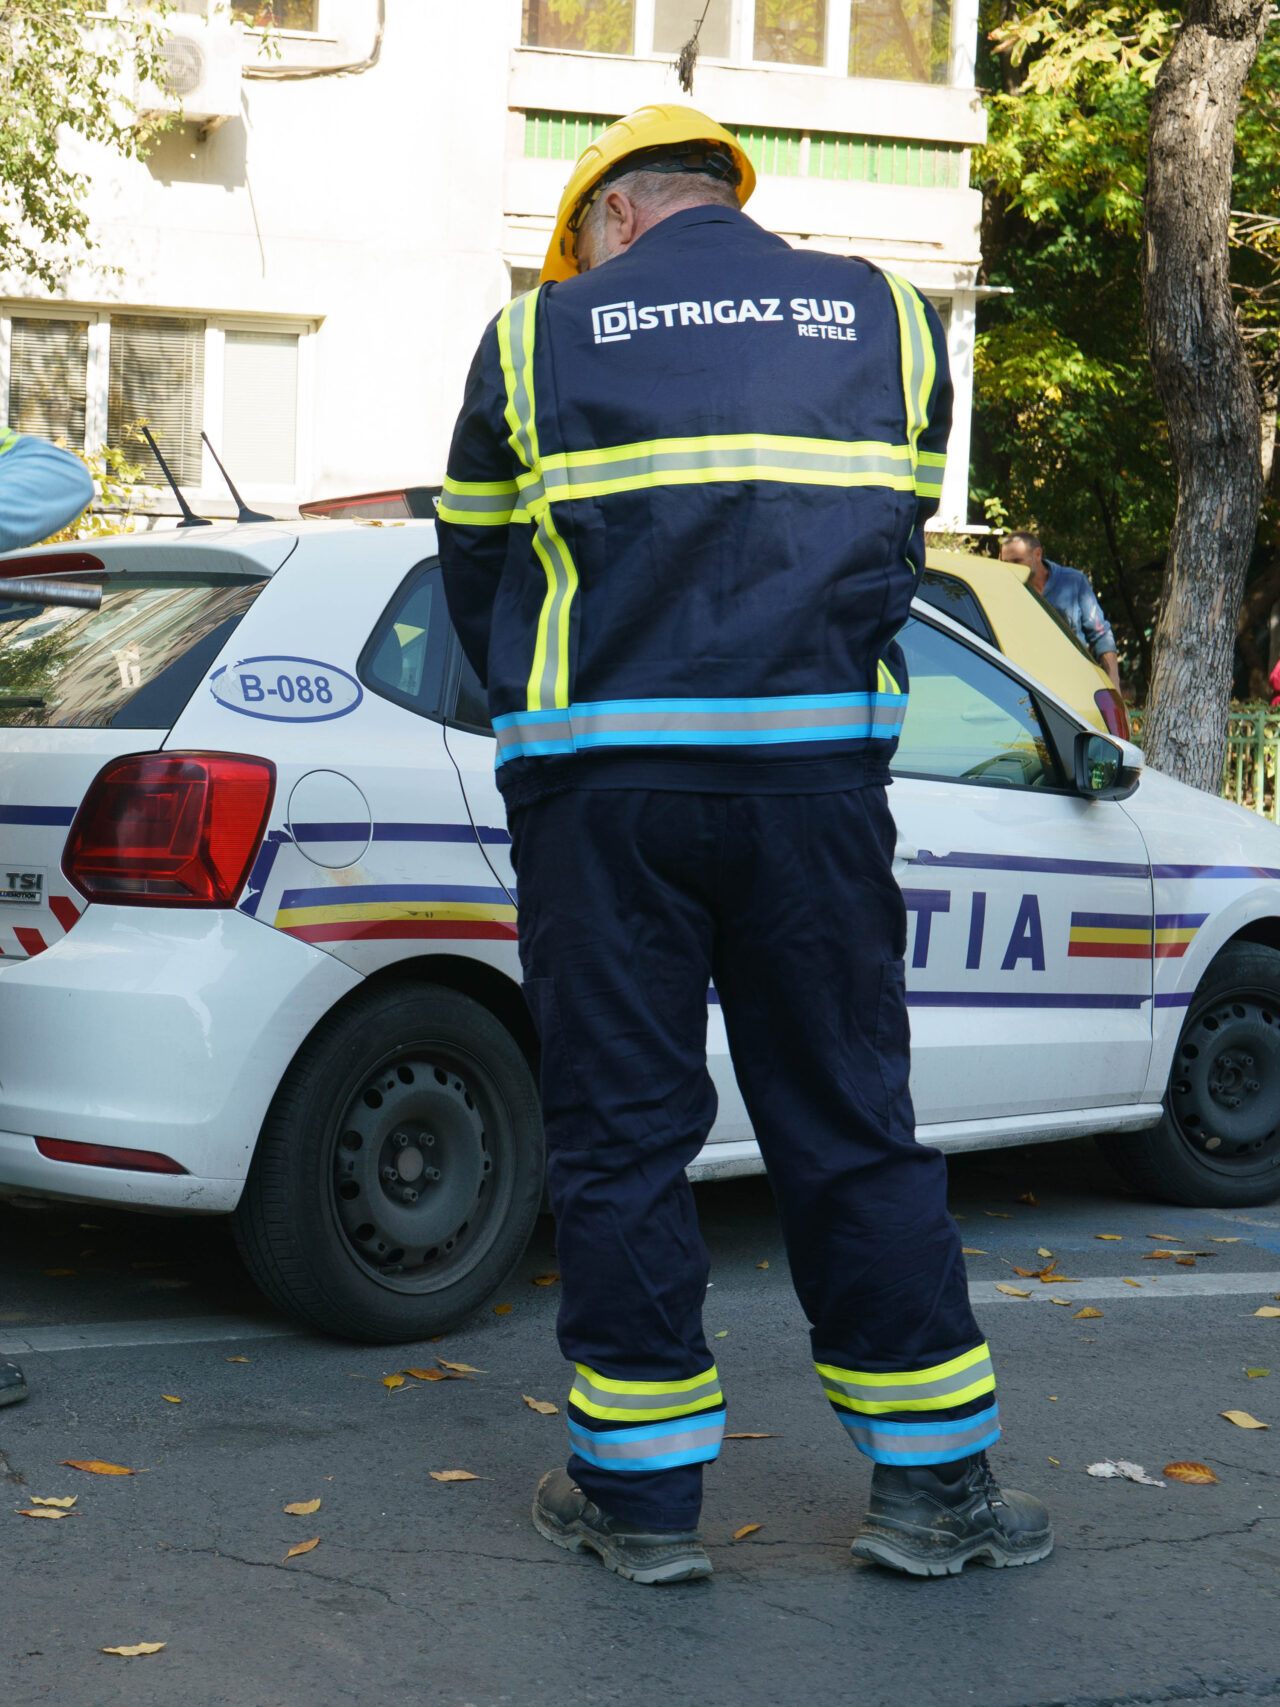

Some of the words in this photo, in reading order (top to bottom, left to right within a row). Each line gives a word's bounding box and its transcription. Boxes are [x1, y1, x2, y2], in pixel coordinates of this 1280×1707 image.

[591, 298, 784, 345] DISTRIGAZ
[790, 298, 856, 325] SUD
[239, 674, 333, 704] B-088
[6, 872, 44, 890] TSI
